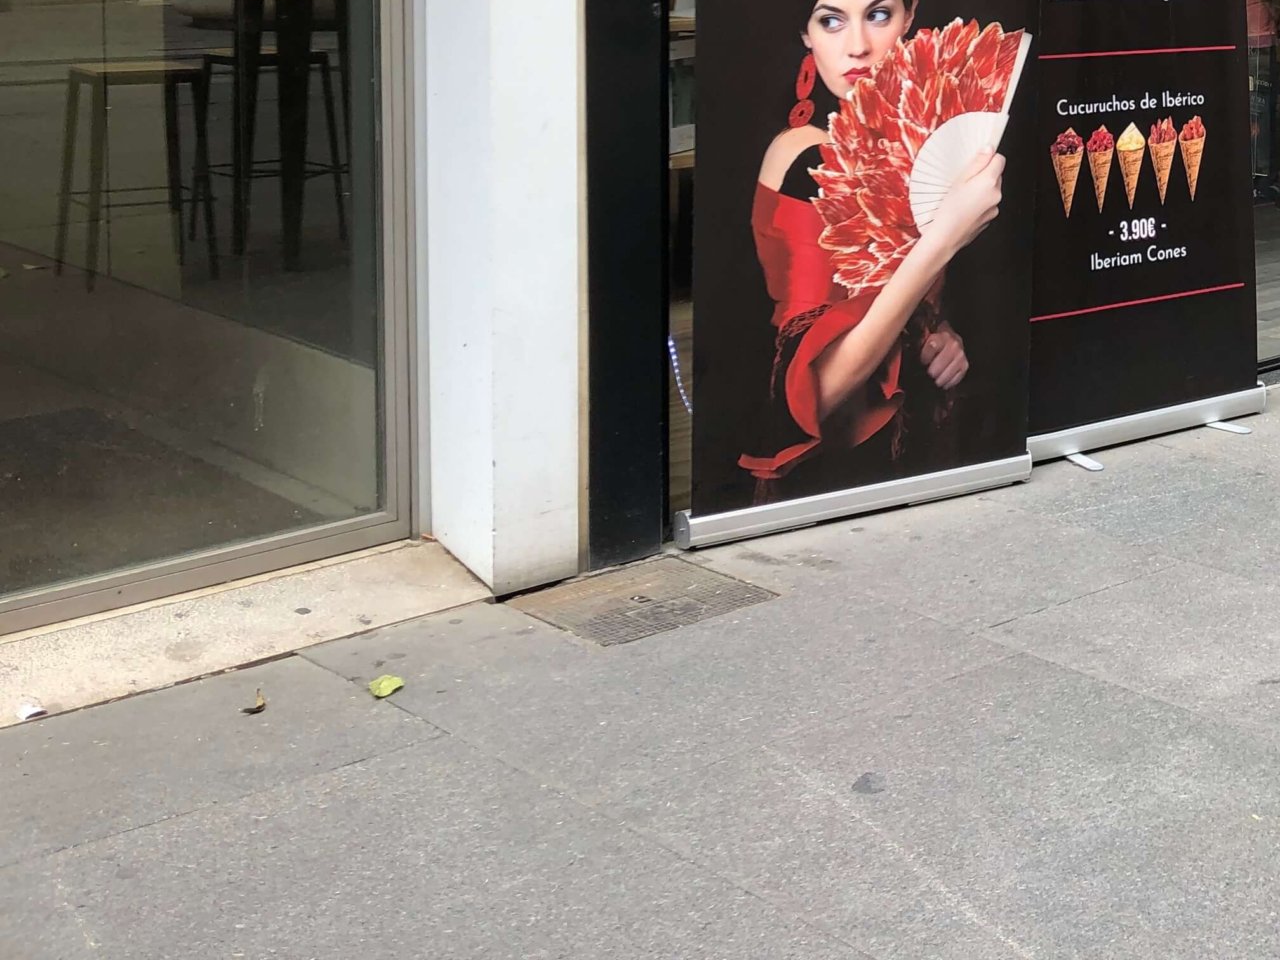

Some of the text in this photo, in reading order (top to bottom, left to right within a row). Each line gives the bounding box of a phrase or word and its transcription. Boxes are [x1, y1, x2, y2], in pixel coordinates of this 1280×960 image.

[1056, 91, 1205, 116] Cucuruchos de Ibérico
[1119, 217, 1156, 241] 3.90€
[1090, 245, 1187, 271] Iberiam Cones
